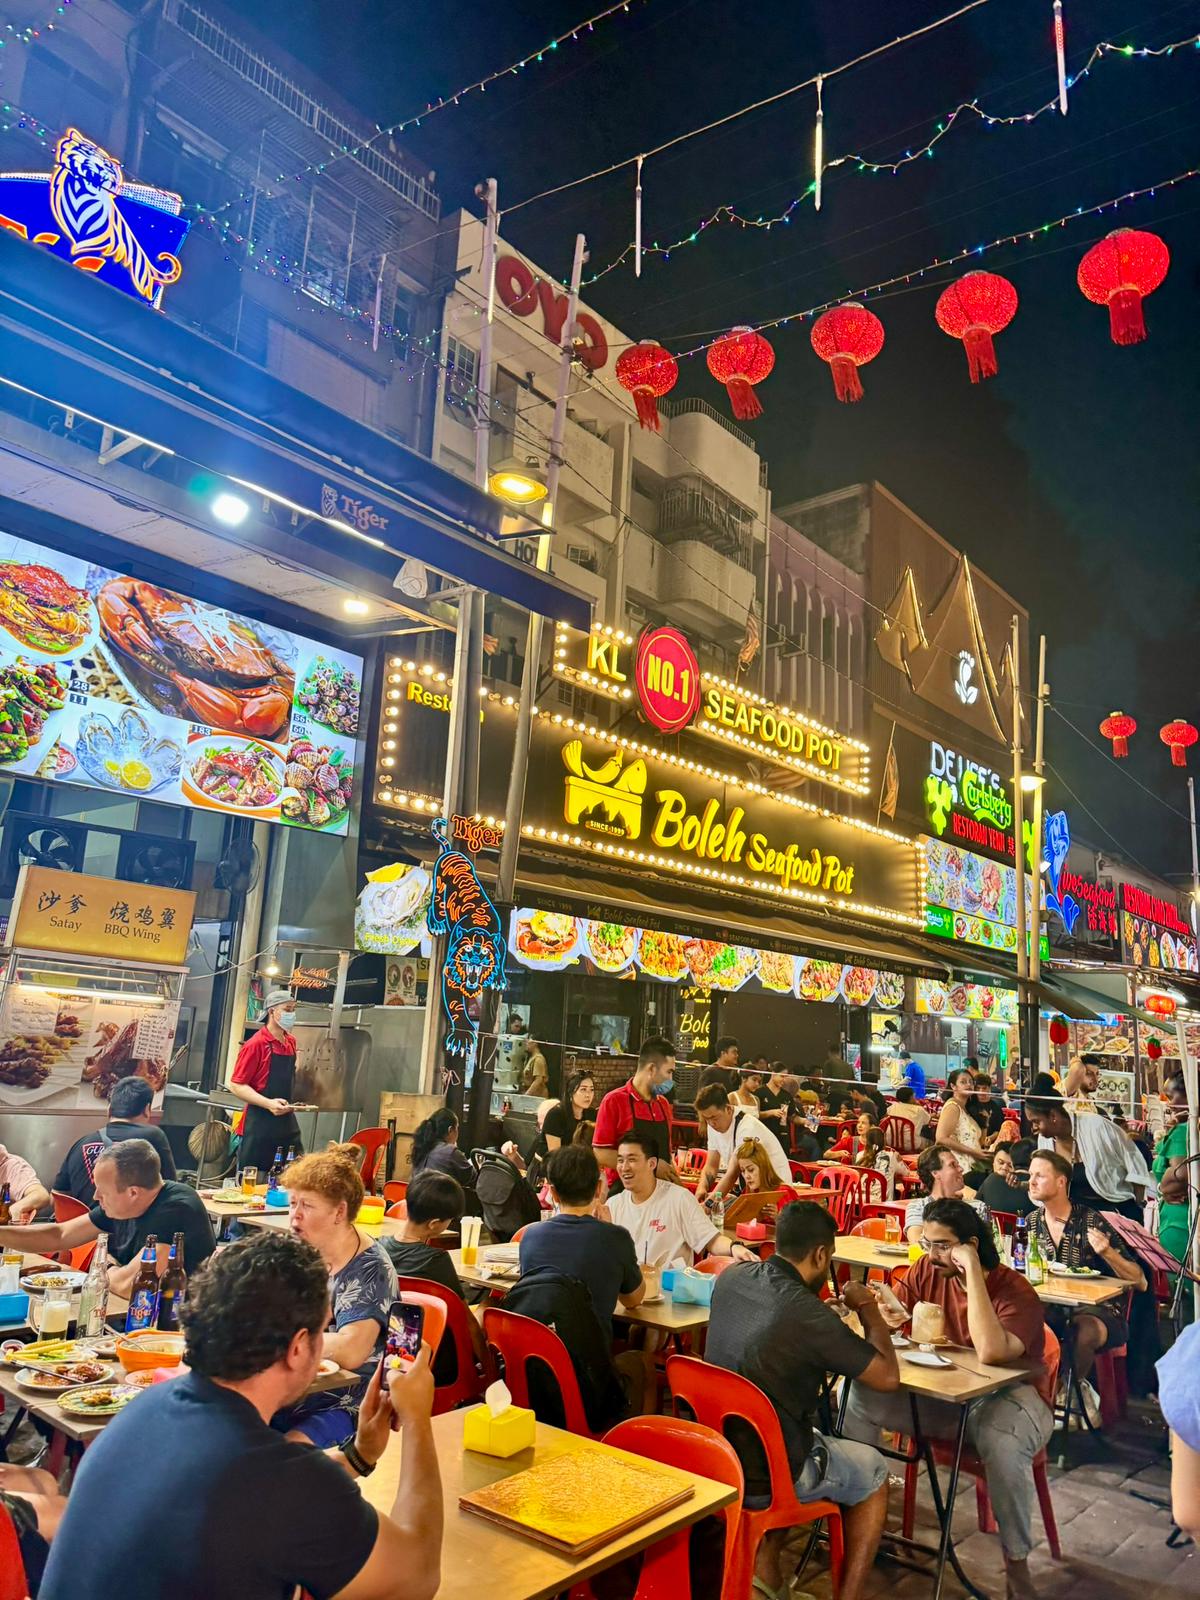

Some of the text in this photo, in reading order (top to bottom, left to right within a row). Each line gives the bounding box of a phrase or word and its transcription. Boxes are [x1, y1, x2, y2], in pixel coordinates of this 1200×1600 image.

[494, 255, 608, 370] OYO
[341, 495, 388, 531] Tiger
[587, 636, 627, 682] KL
[74, 681, 89, 691] 28
[647, 653, 690, 705] NO.1
[72, 694, 86, 705] 11
[193, 726, 211, 736] 183
[703, 689, 843, 770] SEAFOOD POT
[962, 768, 1012, 829] Carlsberg
[452, 814, 504, 853] Tiger
[590, 820, 609, 831] SINCE
[651, 789, 855, 895] Boleh Seafood Pot
[37, 890, 177, 931] 沙爹 烧鸡翼
[50, 916, 82, 933] Satay
[104, 923, 161, 943] BBQ Wing
[130, 1306, 153, 1321] Tiger
